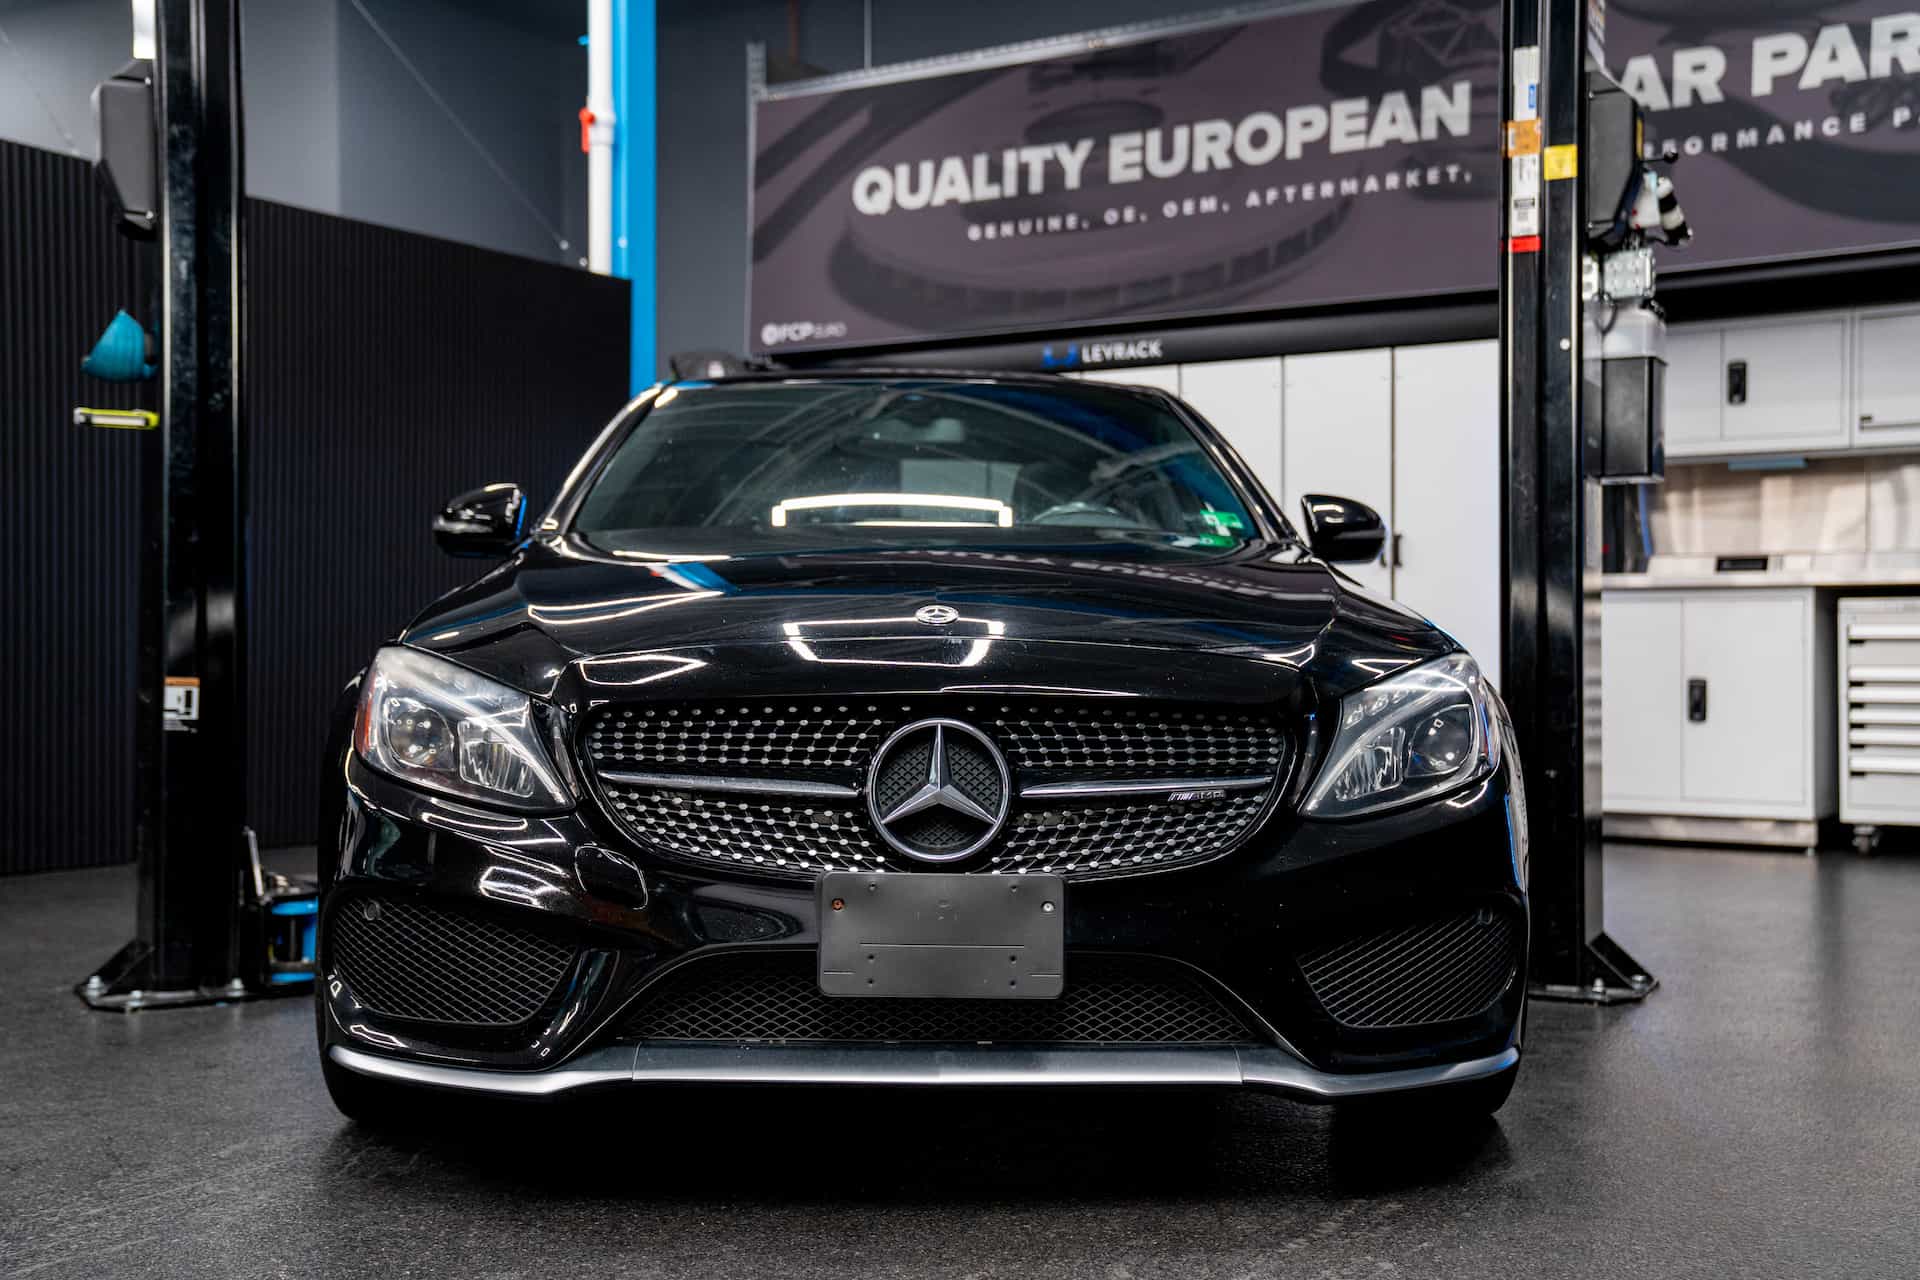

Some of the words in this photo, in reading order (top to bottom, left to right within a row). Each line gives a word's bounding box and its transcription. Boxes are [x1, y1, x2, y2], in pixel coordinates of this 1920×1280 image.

[1621, 46, 1726, 111] AR
[1893, 106, 1920, 128] P
[852, 138, 1094, 215] QUALITY
[1108, 81, 1471, 184] EUROPEAN
[1082, 340, 1162, 363] LEVRACK
